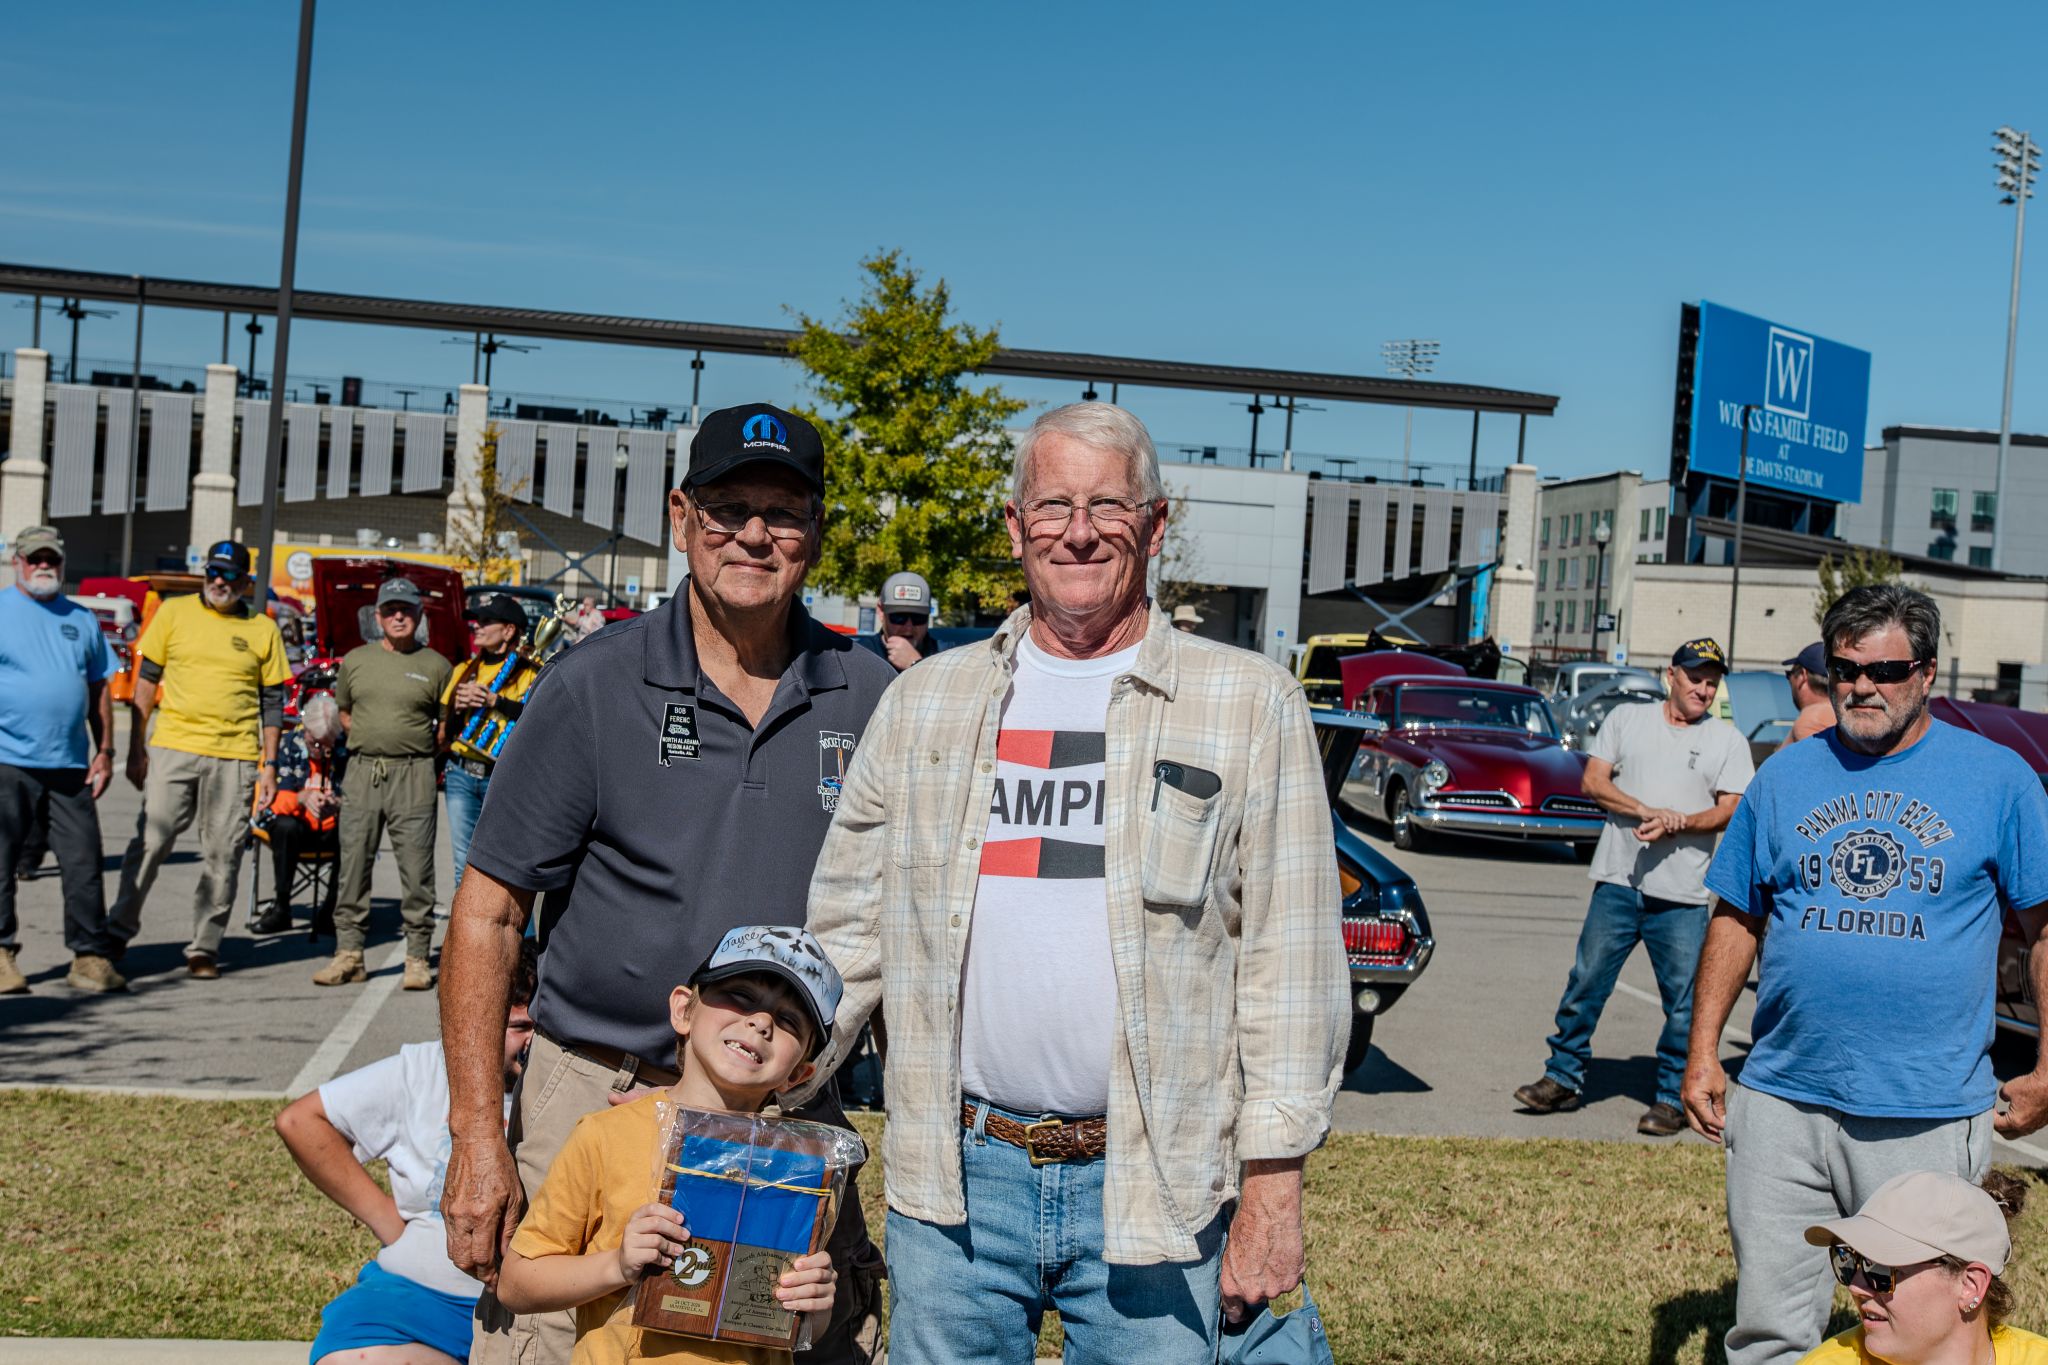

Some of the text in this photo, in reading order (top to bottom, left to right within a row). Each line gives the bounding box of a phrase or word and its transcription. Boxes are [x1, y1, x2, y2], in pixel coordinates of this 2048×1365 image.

[1774, 340, 1808, 403] W
[743, 440, 787, 451] MOPAR
[1764, 411, 1812, 445] FAMILY
[1813, 424, 1849, 454] FIELD
[1777, 443, 1790, 460] AT
[1756, 458, 1783, 480] DAVIS
[1784, 465, 1824, 489] STADIUM
[669, 715, 691, 724] FERENC
[674, 706, 687, 715] BOB
[662, 736, 700, 746] NORTH ALABAMA
[819, 737, 857, 753] ROCKET CITY
[1795, 790, 1955, 849] PANAMA CITY BEACH
[1836, 836, 1898, 862] THE ORIGINAL
[1798, 852, 1945, 896] 19 53
[1850, 849, 1883, 880] FL
[1835, 867, 1897, 894] BEACH PARADISE
[1800, 905, 1927, 941] FLORIDA
[721, 931, 760, 953] Jayce
[677, 1250, 711, 1279] 2nd
